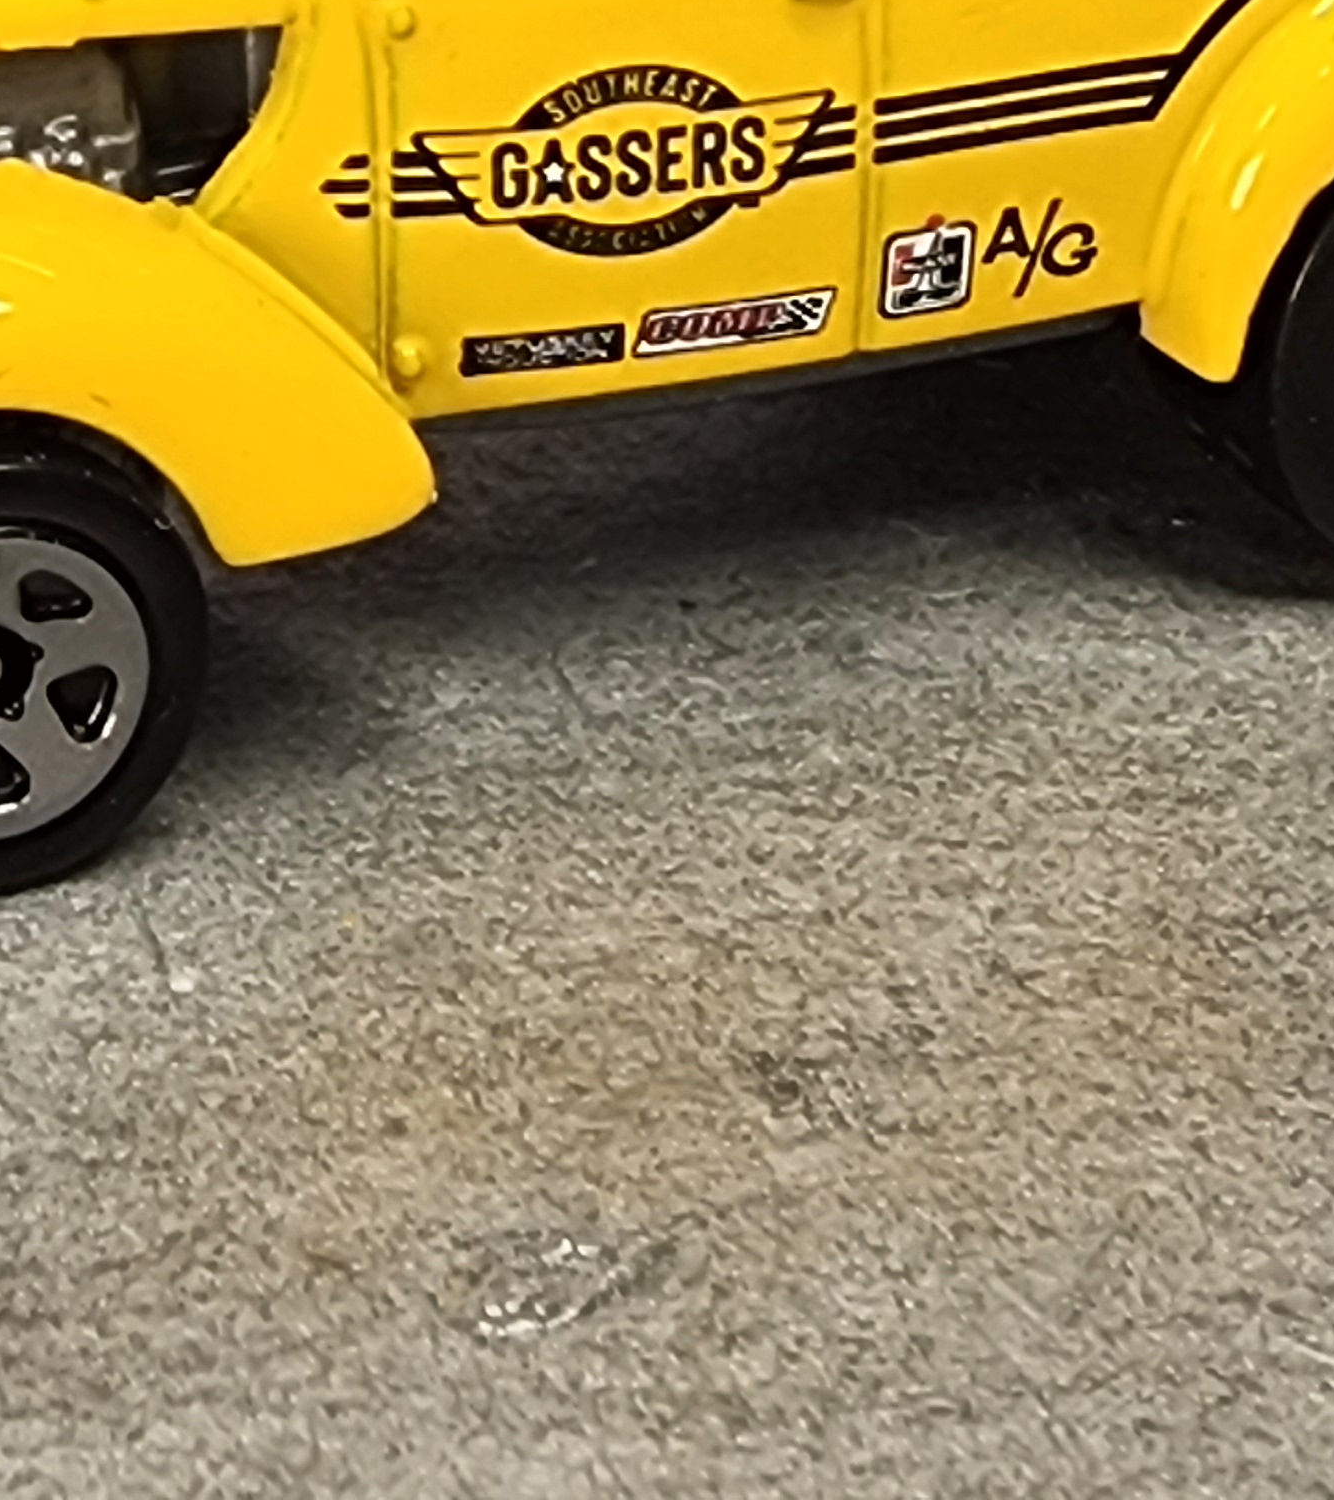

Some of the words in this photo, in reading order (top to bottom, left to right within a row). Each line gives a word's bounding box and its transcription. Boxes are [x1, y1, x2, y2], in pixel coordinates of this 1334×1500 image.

[543, 70, 718, 123] SOUTHEAST
[490, 115, 766, 209] GASSERS
[980, 197, 1099, 298] A/G
